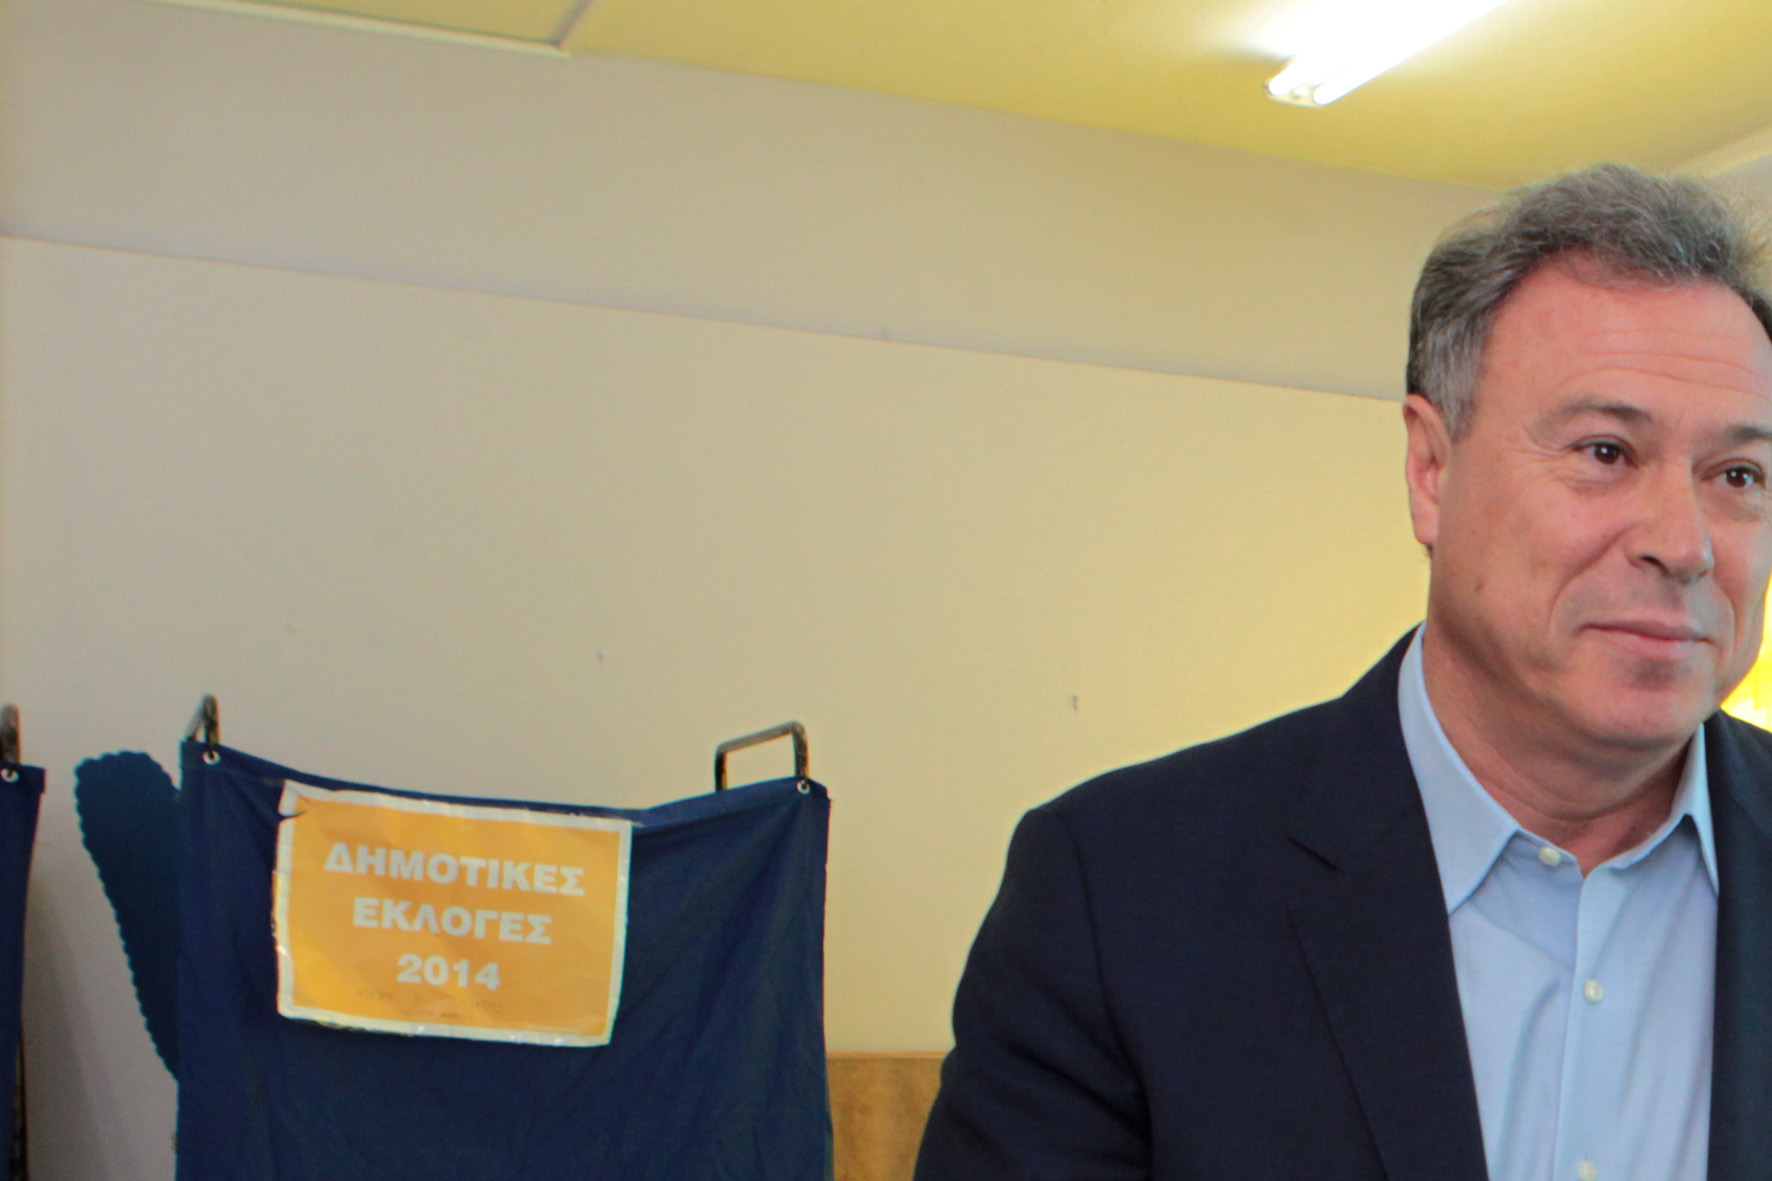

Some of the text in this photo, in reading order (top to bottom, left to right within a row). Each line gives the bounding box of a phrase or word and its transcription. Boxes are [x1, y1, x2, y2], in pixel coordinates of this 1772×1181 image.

[323, 842, 586, 897] ΔΗΜΟΤΙΚΕΣ
[353, 897, 553, 945] ΕΚΛΟΓΕΣ
[396, 953, 501, 992] 2014
